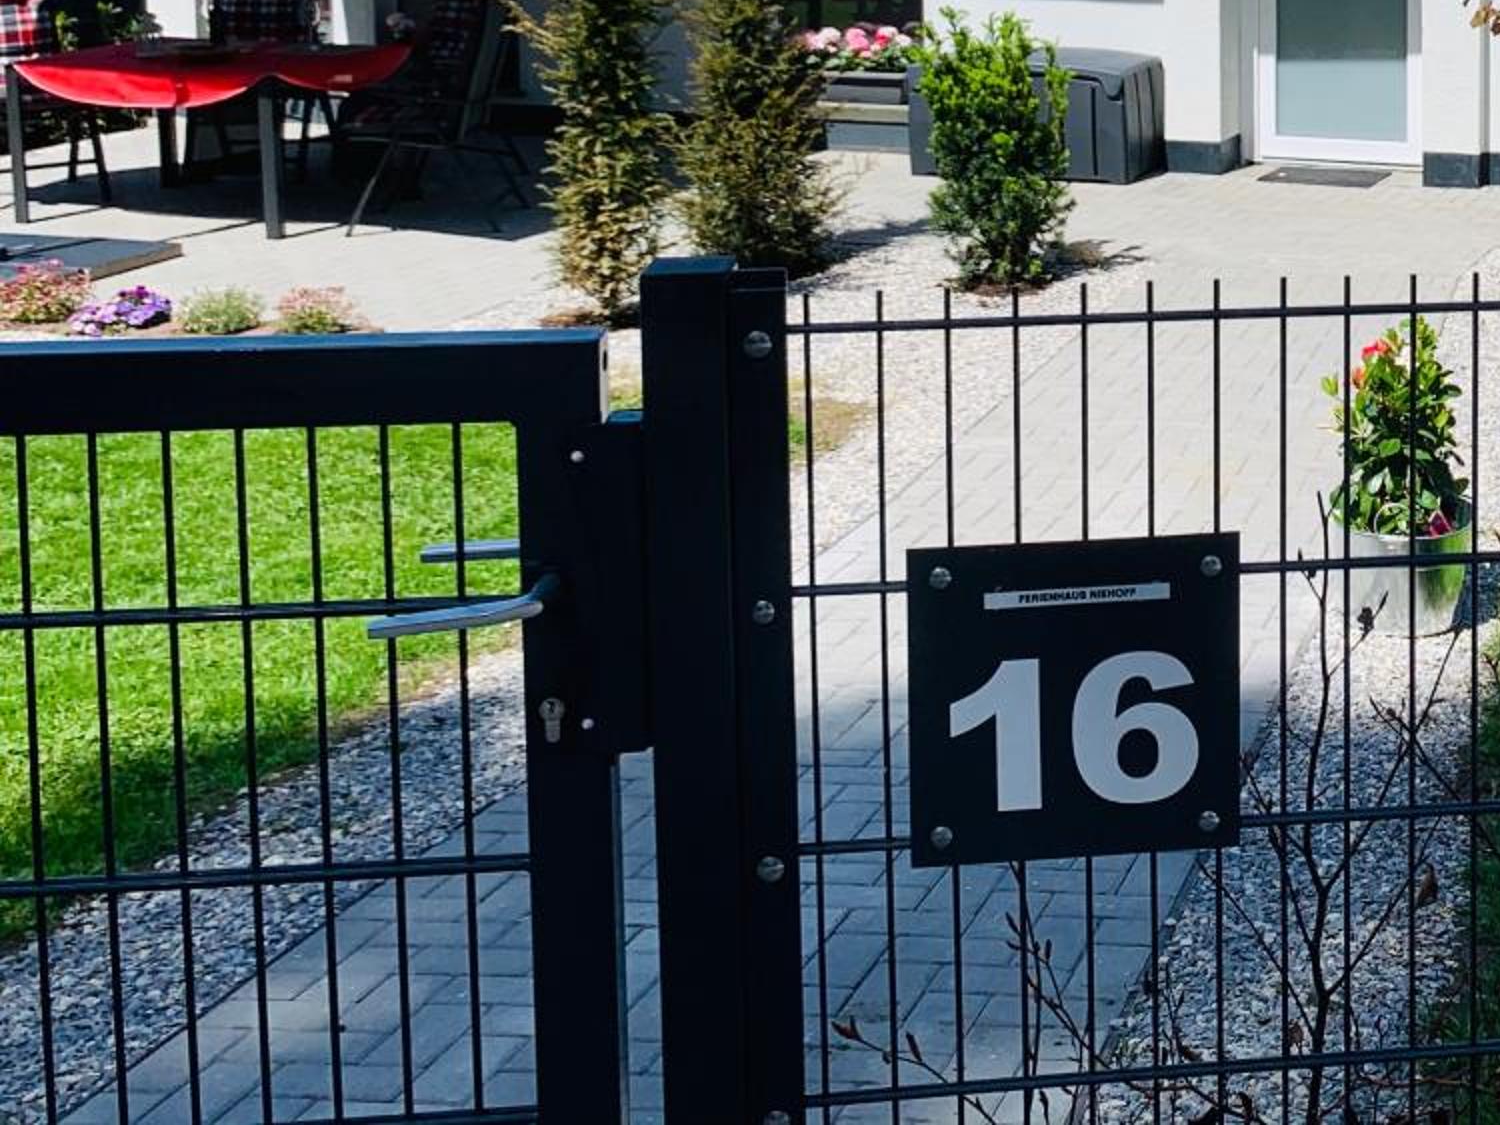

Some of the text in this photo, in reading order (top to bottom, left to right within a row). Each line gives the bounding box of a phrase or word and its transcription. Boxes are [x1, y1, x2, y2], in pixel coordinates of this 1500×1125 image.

[1018, 587, 1137, 604] FERIENHAUS NIEHOFF
[950, 651, 1199, 812] 16
